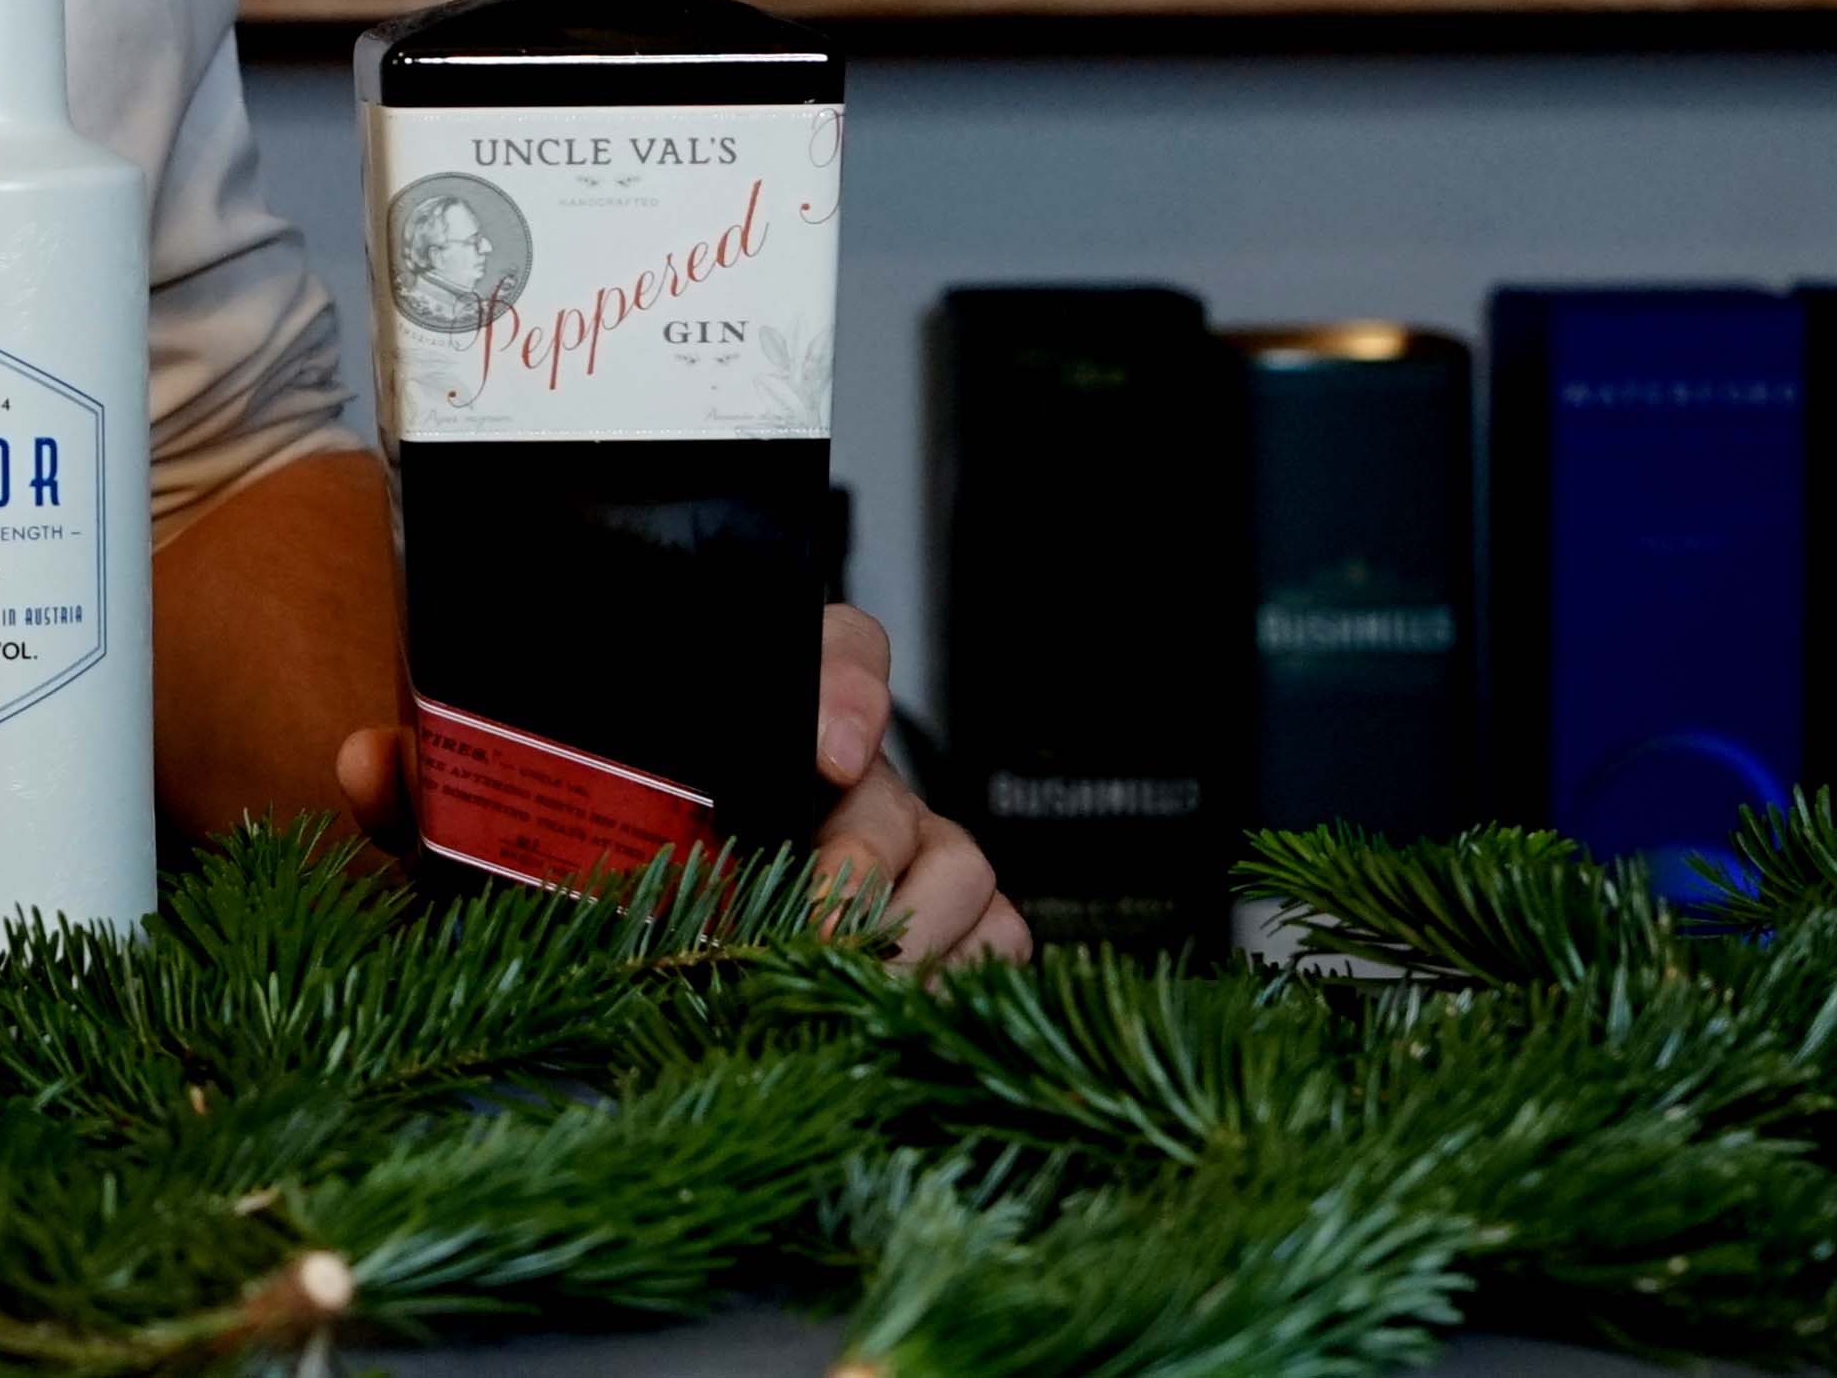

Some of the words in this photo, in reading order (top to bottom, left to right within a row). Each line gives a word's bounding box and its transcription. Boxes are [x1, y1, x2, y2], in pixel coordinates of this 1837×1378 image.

[472, 138, 612, 166] UNCLE
[628, 137, 739, 165] VAL'S
[447, 179, 770, 409] Peppered
[663, 320, 751, 344] GIN
[2, 608, 17, 626] IN
[25, 605, 83, 626] AUSTRIA
